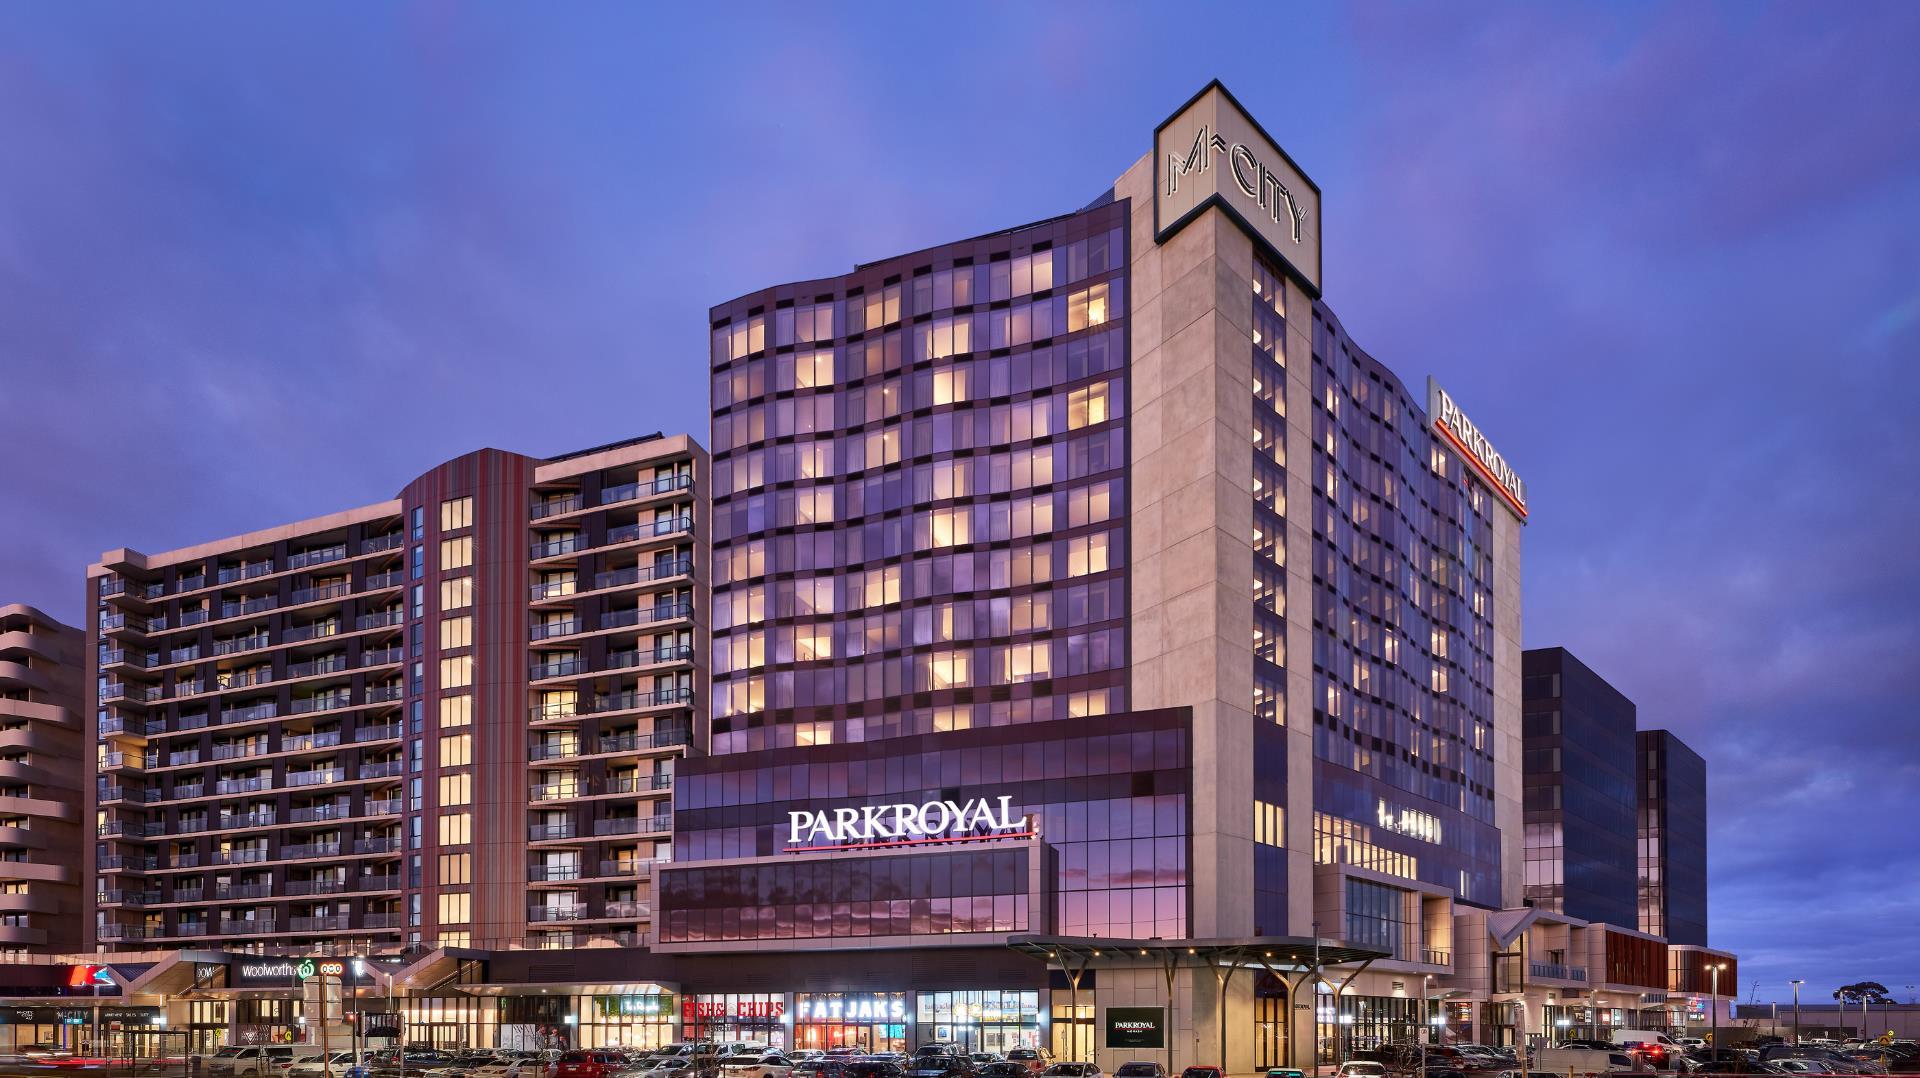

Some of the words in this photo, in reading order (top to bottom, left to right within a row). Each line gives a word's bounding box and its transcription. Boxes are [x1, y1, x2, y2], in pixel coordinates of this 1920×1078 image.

[1439, 388, 1526, 507] PARKROYAL
[787, 795, 1028, 843] PARKROYAL
[738, 1002, 784, 1017] CHIPS
